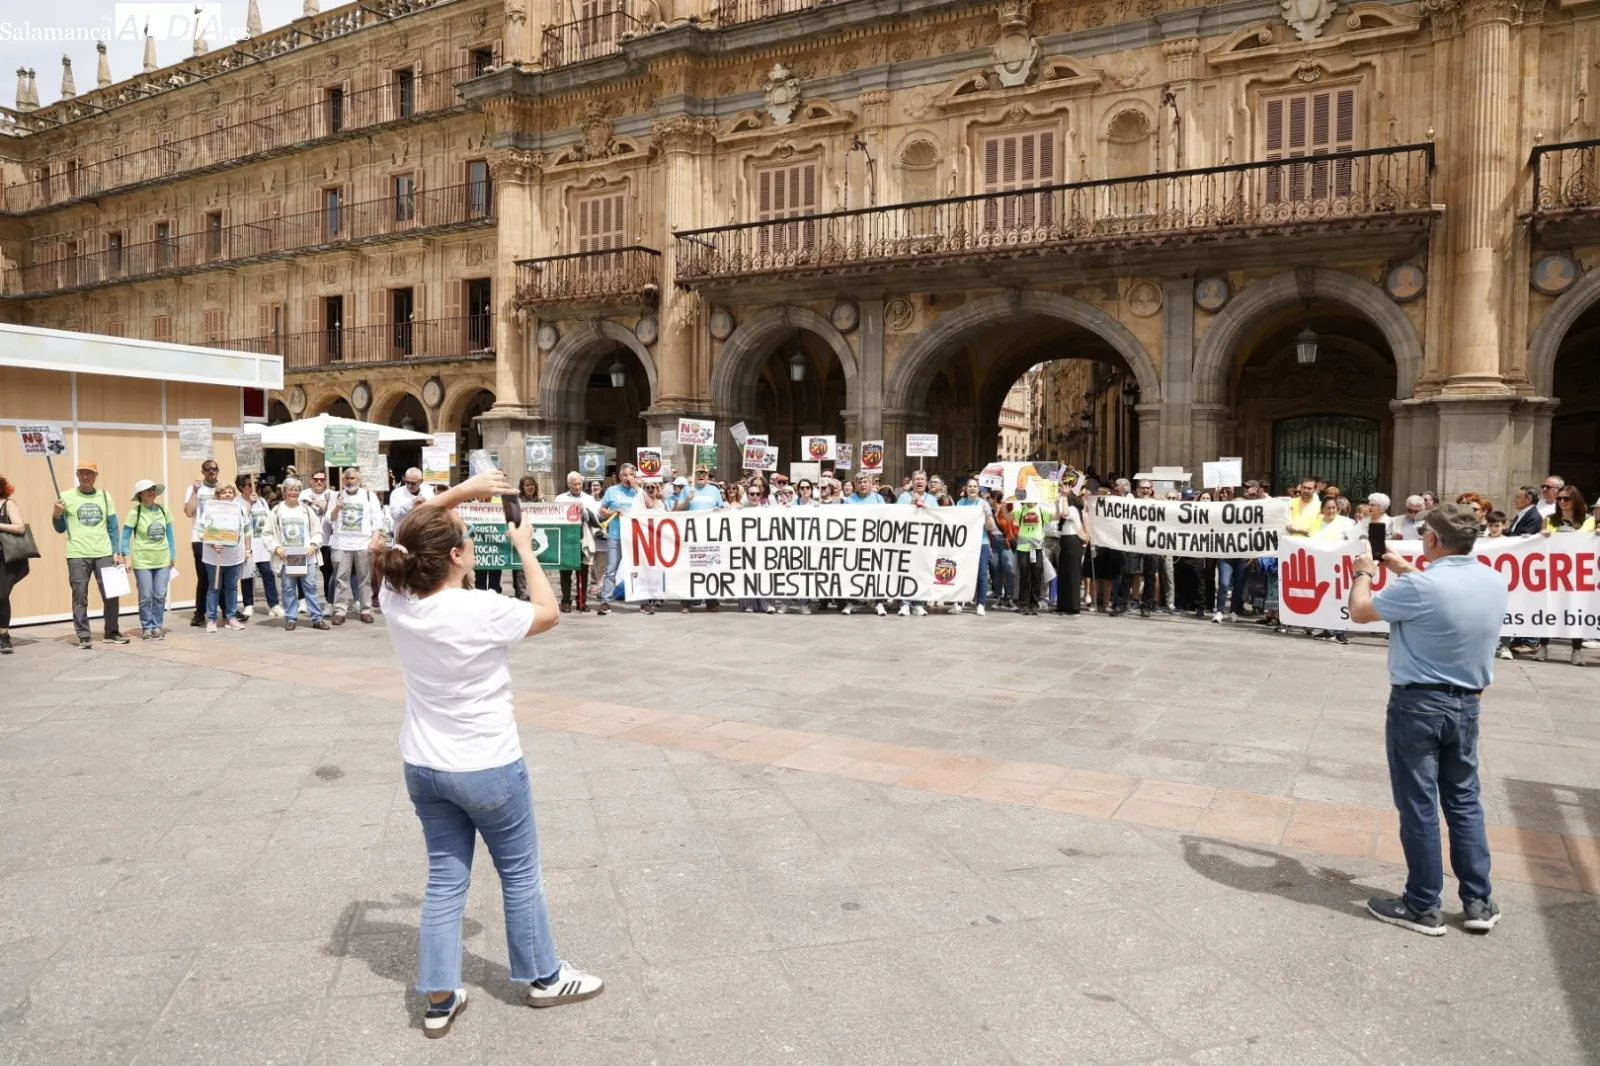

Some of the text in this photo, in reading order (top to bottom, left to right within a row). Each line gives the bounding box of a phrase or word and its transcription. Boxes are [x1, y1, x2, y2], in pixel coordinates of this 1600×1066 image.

[631, 517, 967, 568] NO A LA PLANTA DE BIOMETANO
[474, 554, 505, 567] RACIAS
[729, 546, 756, 570] EN
[764, 546, 912, 572] BABILAFUENTE
[690, 572, 918, 598] POR NUESTRA SALUD
[1531, 608, 1557, 626] de
